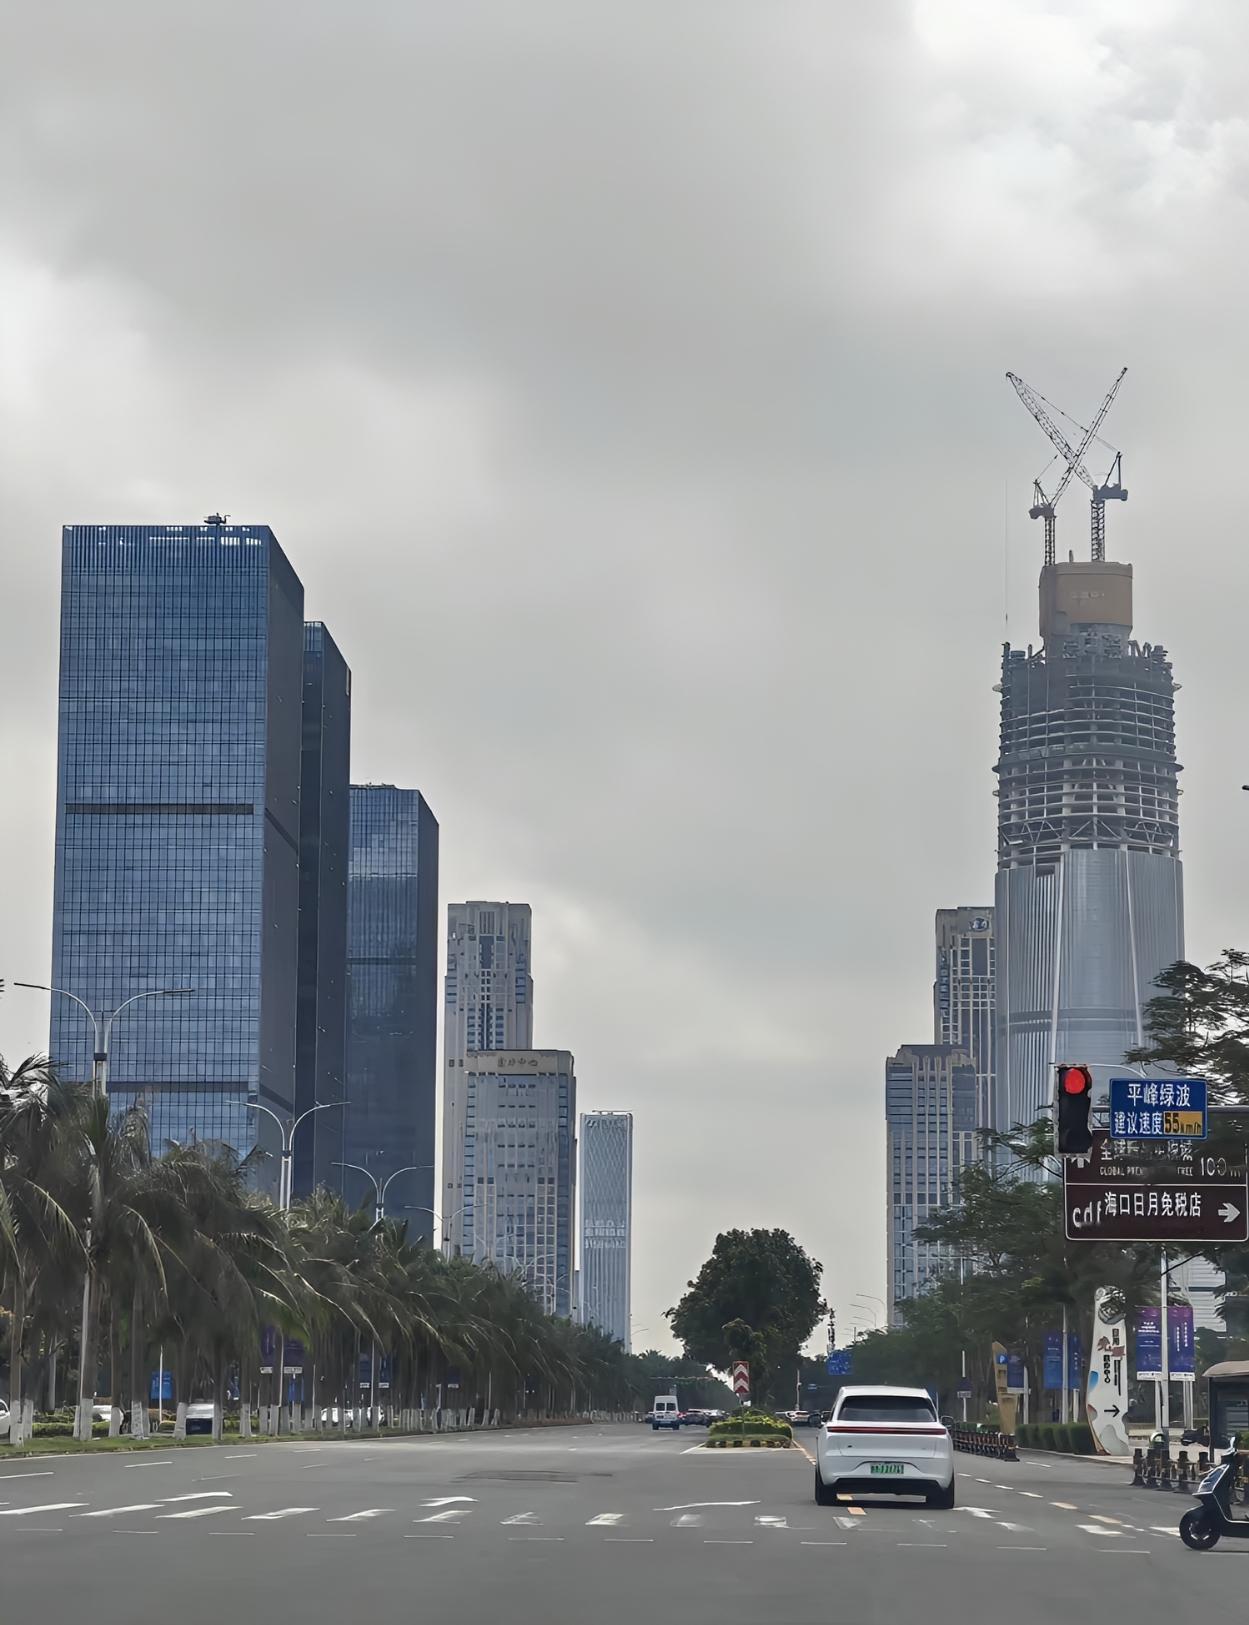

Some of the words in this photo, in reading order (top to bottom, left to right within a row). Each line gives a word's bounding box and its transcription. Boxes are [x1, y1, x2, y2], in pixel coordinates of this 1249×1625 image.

[1127, 1083, 1190, 1107] 平峰绿波
[1114, 1111, 1163, 1135] 建议速度
[1100, 1166, 1124, 1176] GLOBAL
[1072, 1201, 1101, 1227] cdf
[1104, 1191, 1201, 1217] 海口日月免税店
